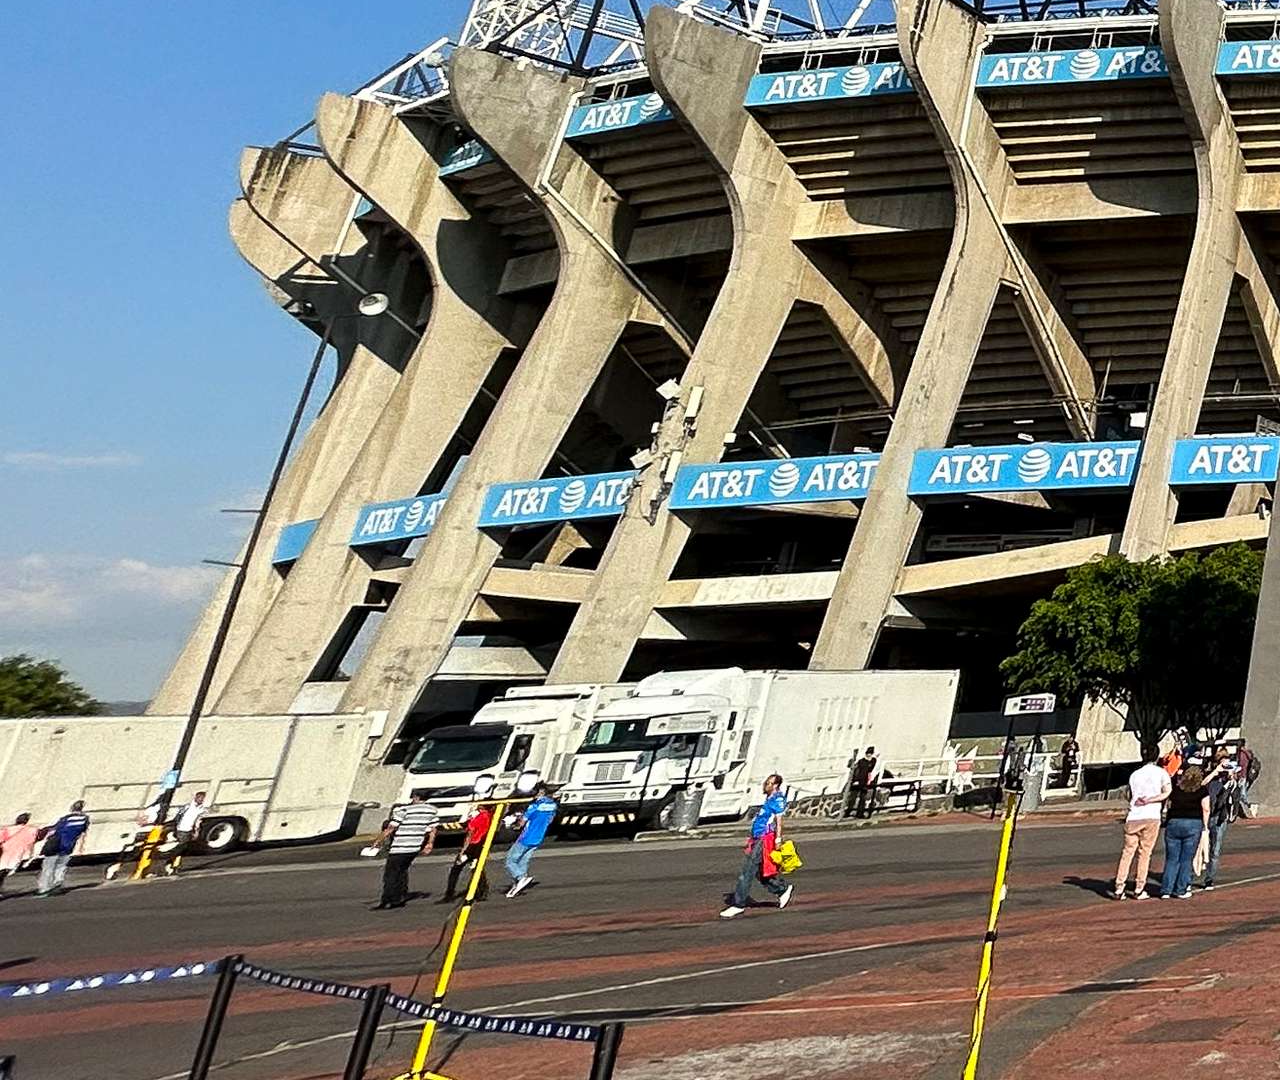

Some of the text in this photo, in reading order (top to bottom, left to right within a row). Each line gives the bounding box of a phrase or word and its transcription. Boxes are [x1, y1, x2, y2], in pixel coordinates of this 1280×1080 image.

[989, 46, 1168, 82] AT&T AT&
[766, 72, 838, 100] AT&T
[579, 101, 637, 130] AT&T
[928, 447, 1138, 484] AT&T AT&T
[1188, 445, 1273, 475] AT&T
[687, 460, 880, 499] AT&T AT&T
[493, 477, 632, 517] AT&T AT&
[360, 507, 405, 536] AT&T
